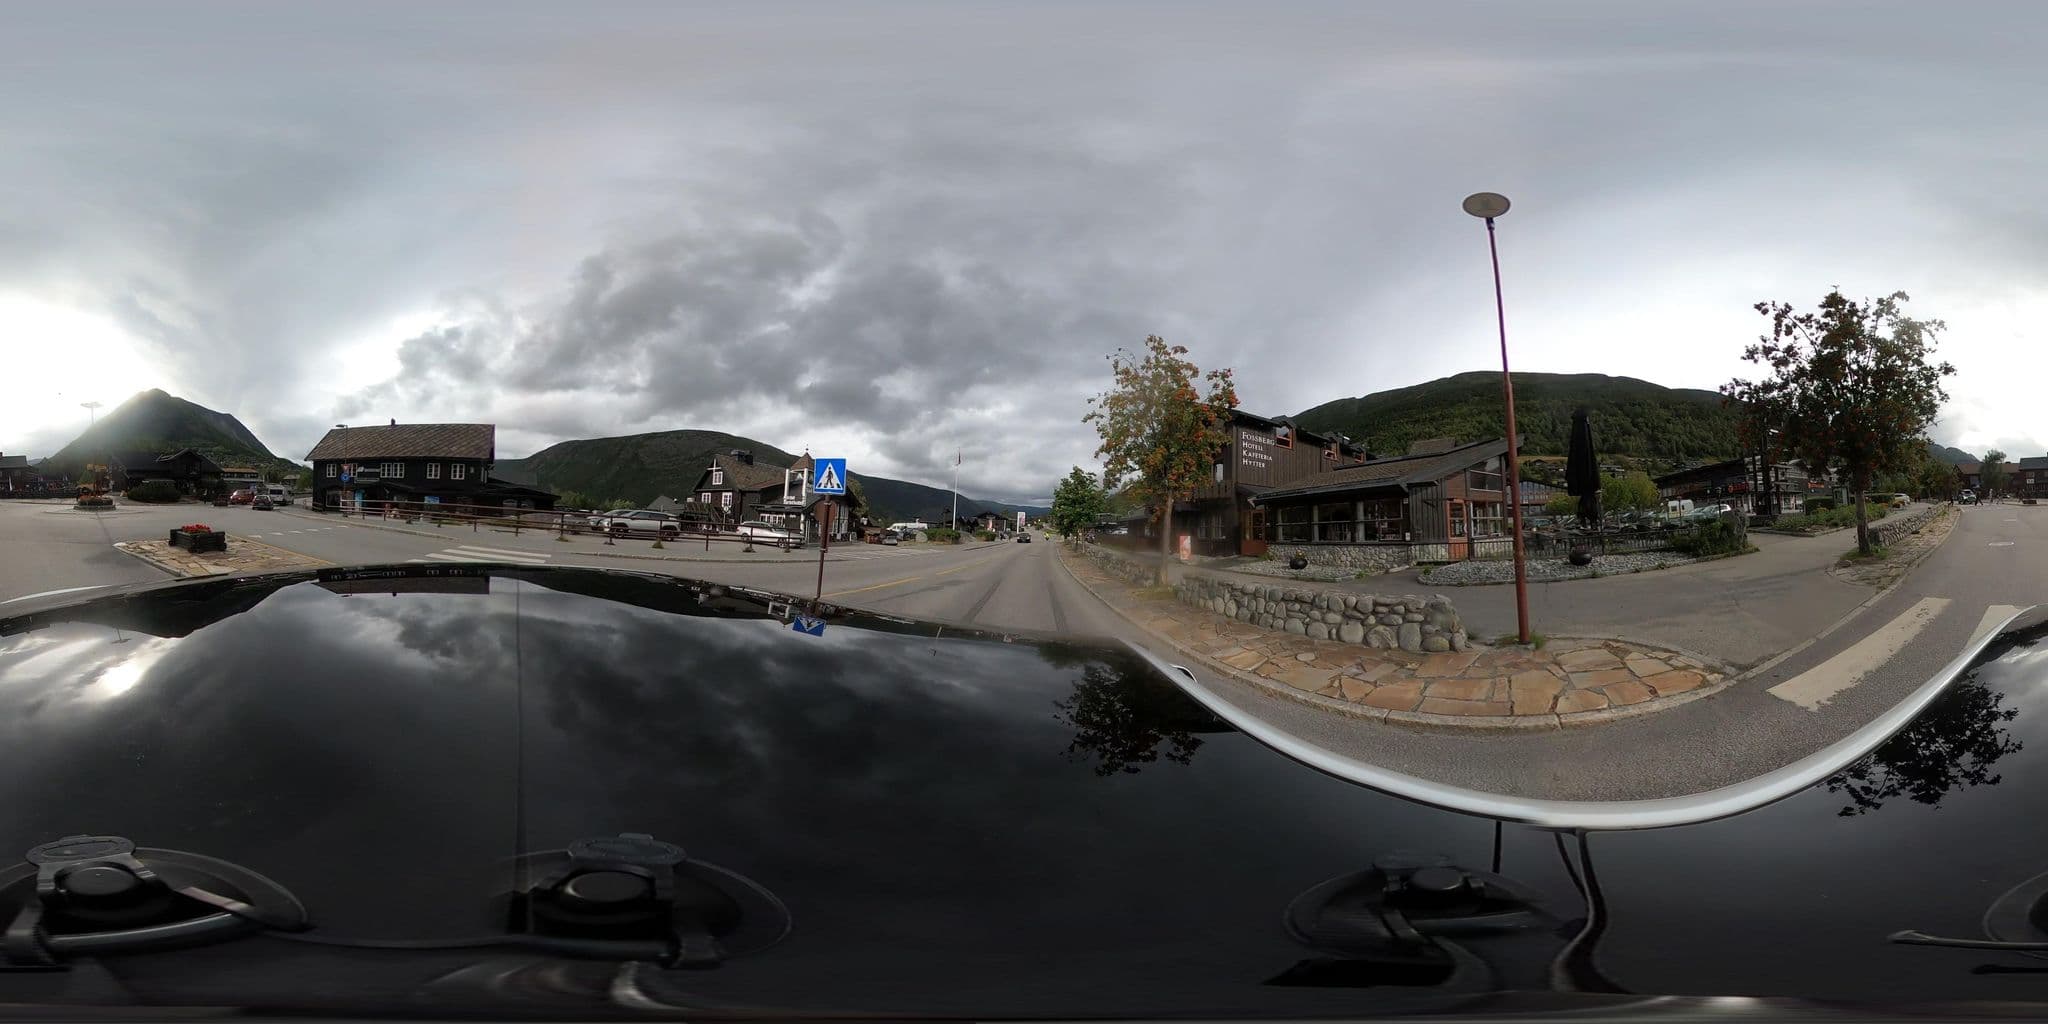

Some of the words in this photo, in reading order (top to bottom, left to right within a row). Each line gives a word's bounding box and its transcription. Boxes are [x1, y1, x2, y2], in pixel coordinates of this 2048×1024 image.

[1242, 431, 1275, 446] FOSSBERG
[1242, 441, 1263, 451] HOTELL
[1242, 449, 1272, 461] KAFETERIA
[1242, 458, 1265, 468] HYTTER
